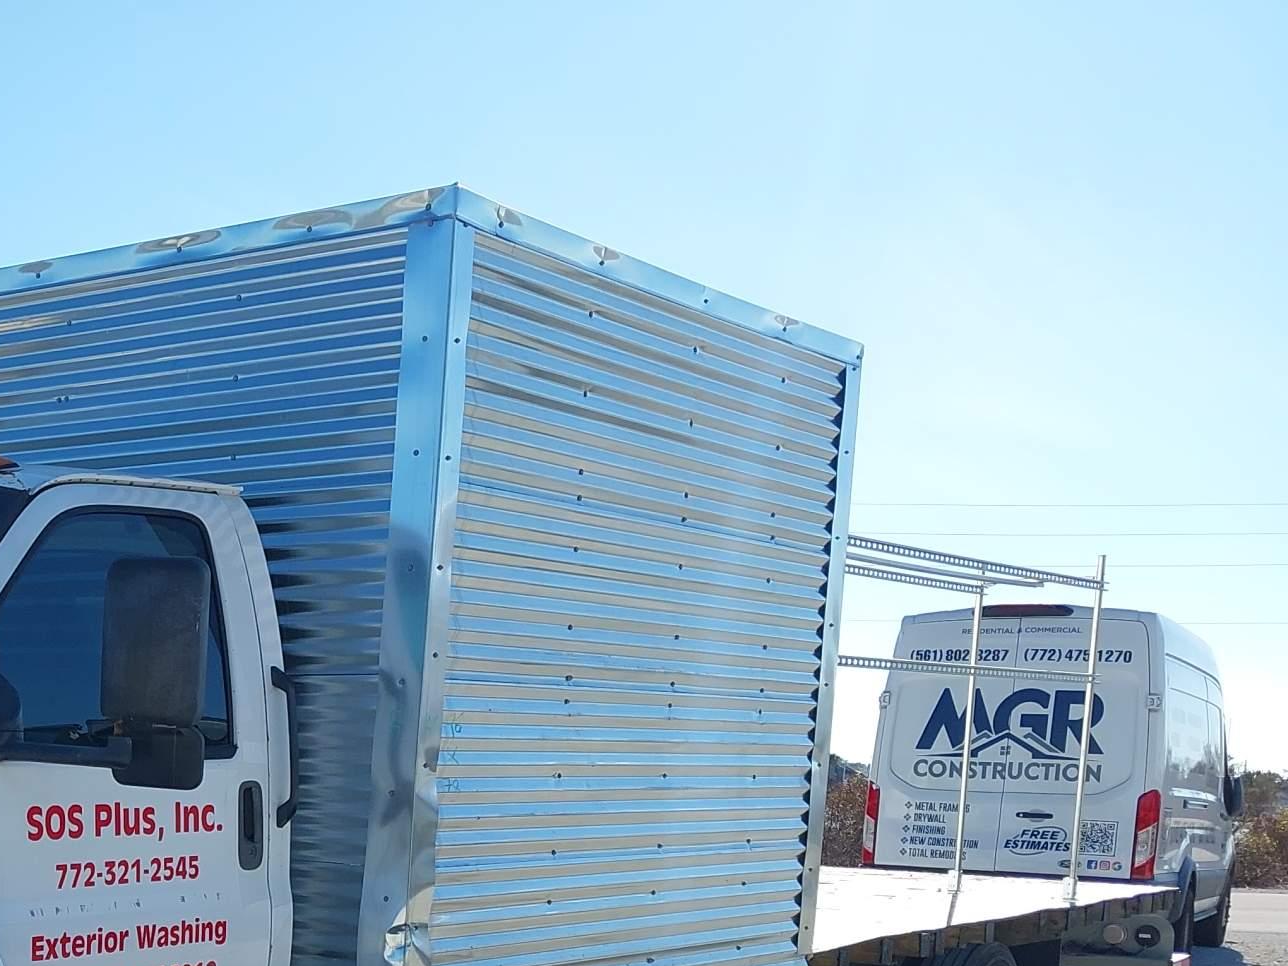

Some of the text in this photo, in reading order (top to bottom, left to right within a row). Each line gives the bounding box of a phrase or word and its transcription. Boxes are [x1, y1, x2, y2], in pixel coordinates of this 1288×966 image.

[1025, 626, 1083, 634] COMMERCIAL
[915, 687, 1104, 755] MGR
[913, 759, 1102, 783] CONSTRUCTION
[915, 802, 971, 813] METAL FRAMG
[26, 801, 223, 842] SOS Plus, Inc.
[914, 813, 947, 824] DRYWALL
[912, 825, 946, 835] FINISHING
[1020, 829, 1061, 840] FREE
[909, 836, 926, 846] NEW
[1003, 839, 1072, 852] ESTIMATES
[908, 848, 929, 858] TOTAL
[55, 855, 200, 890] 772-321-2545
[31, 917, 227, 961] Exterior Washing
